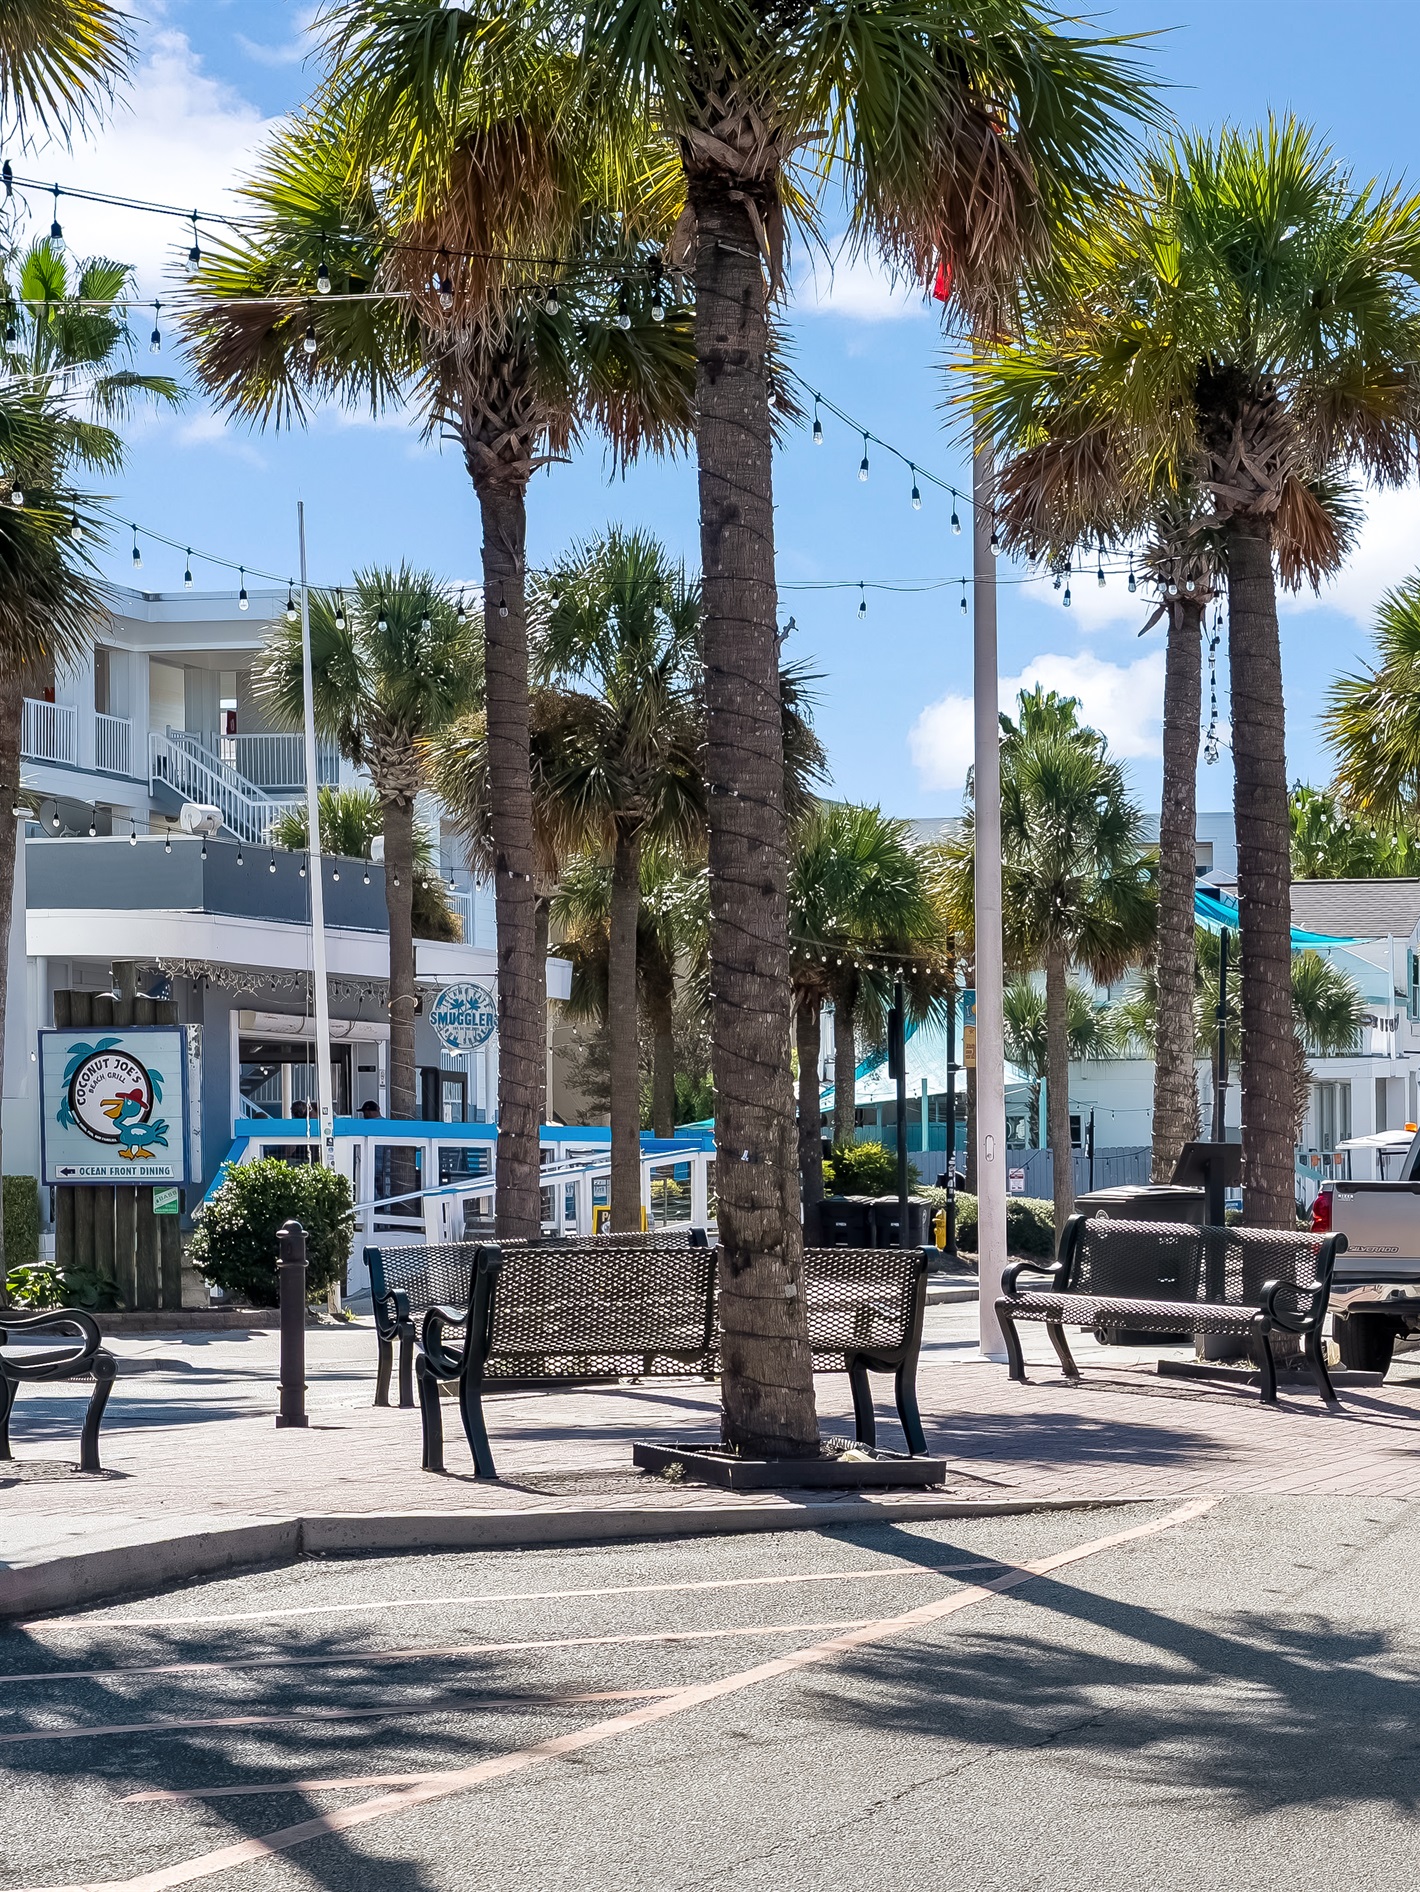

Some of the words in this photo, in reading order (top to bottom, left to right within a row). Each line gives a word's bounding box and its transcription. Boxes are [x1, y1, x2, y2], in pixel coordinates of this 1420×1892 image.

[77, 1058, 109, 1105] COCONUT
[114, 1059, 141, 1083] JOE'S
[89, 1073, 105, 1093] BEACH
[107, 1072, 126, 1084] GRILL
[79, 1167, 107, 1175] OCEAN
[110, 1167, 137, 1175] FRONT
[140, 1167, 170, 1175] DINING
